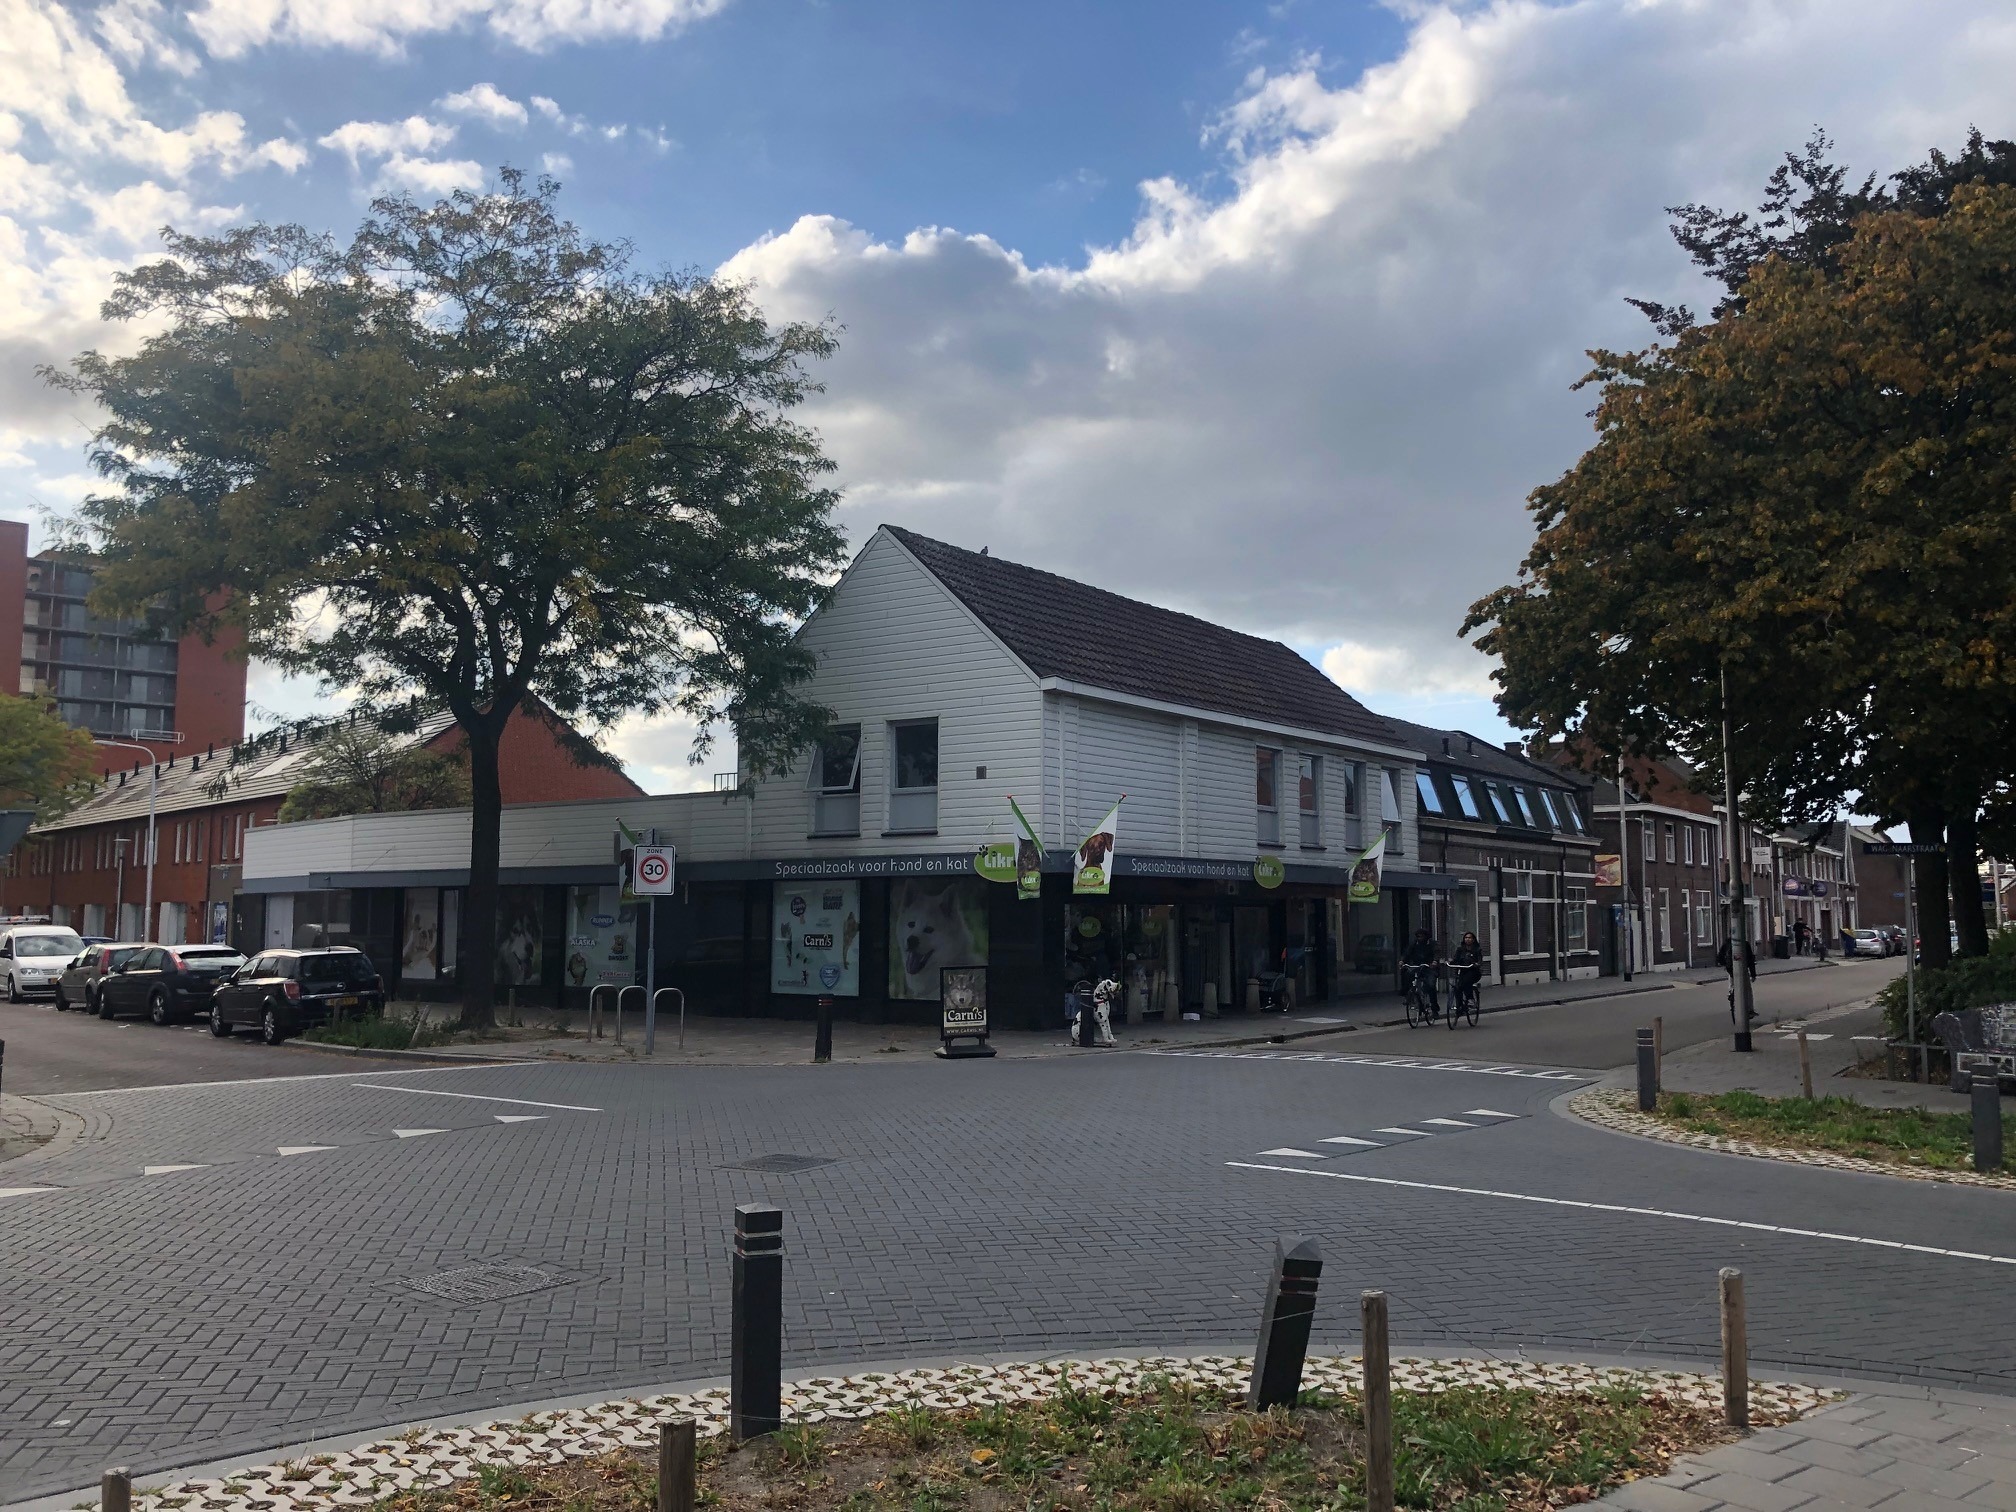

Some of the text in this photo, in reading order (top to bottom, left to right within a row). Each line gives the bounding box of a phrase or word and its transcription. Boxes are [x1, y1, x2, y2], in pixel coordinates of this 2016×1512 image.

[644, 863, 664, 876] 30
[775, 856, 968, 877] Speciaalzaak voor hond en kat
[1131, 857, 1250, 877] Speciaalzaak voor hond en kat
[804, 934, 832, 947] Carnis
[947, 1006, 983, 1021] Carnis
